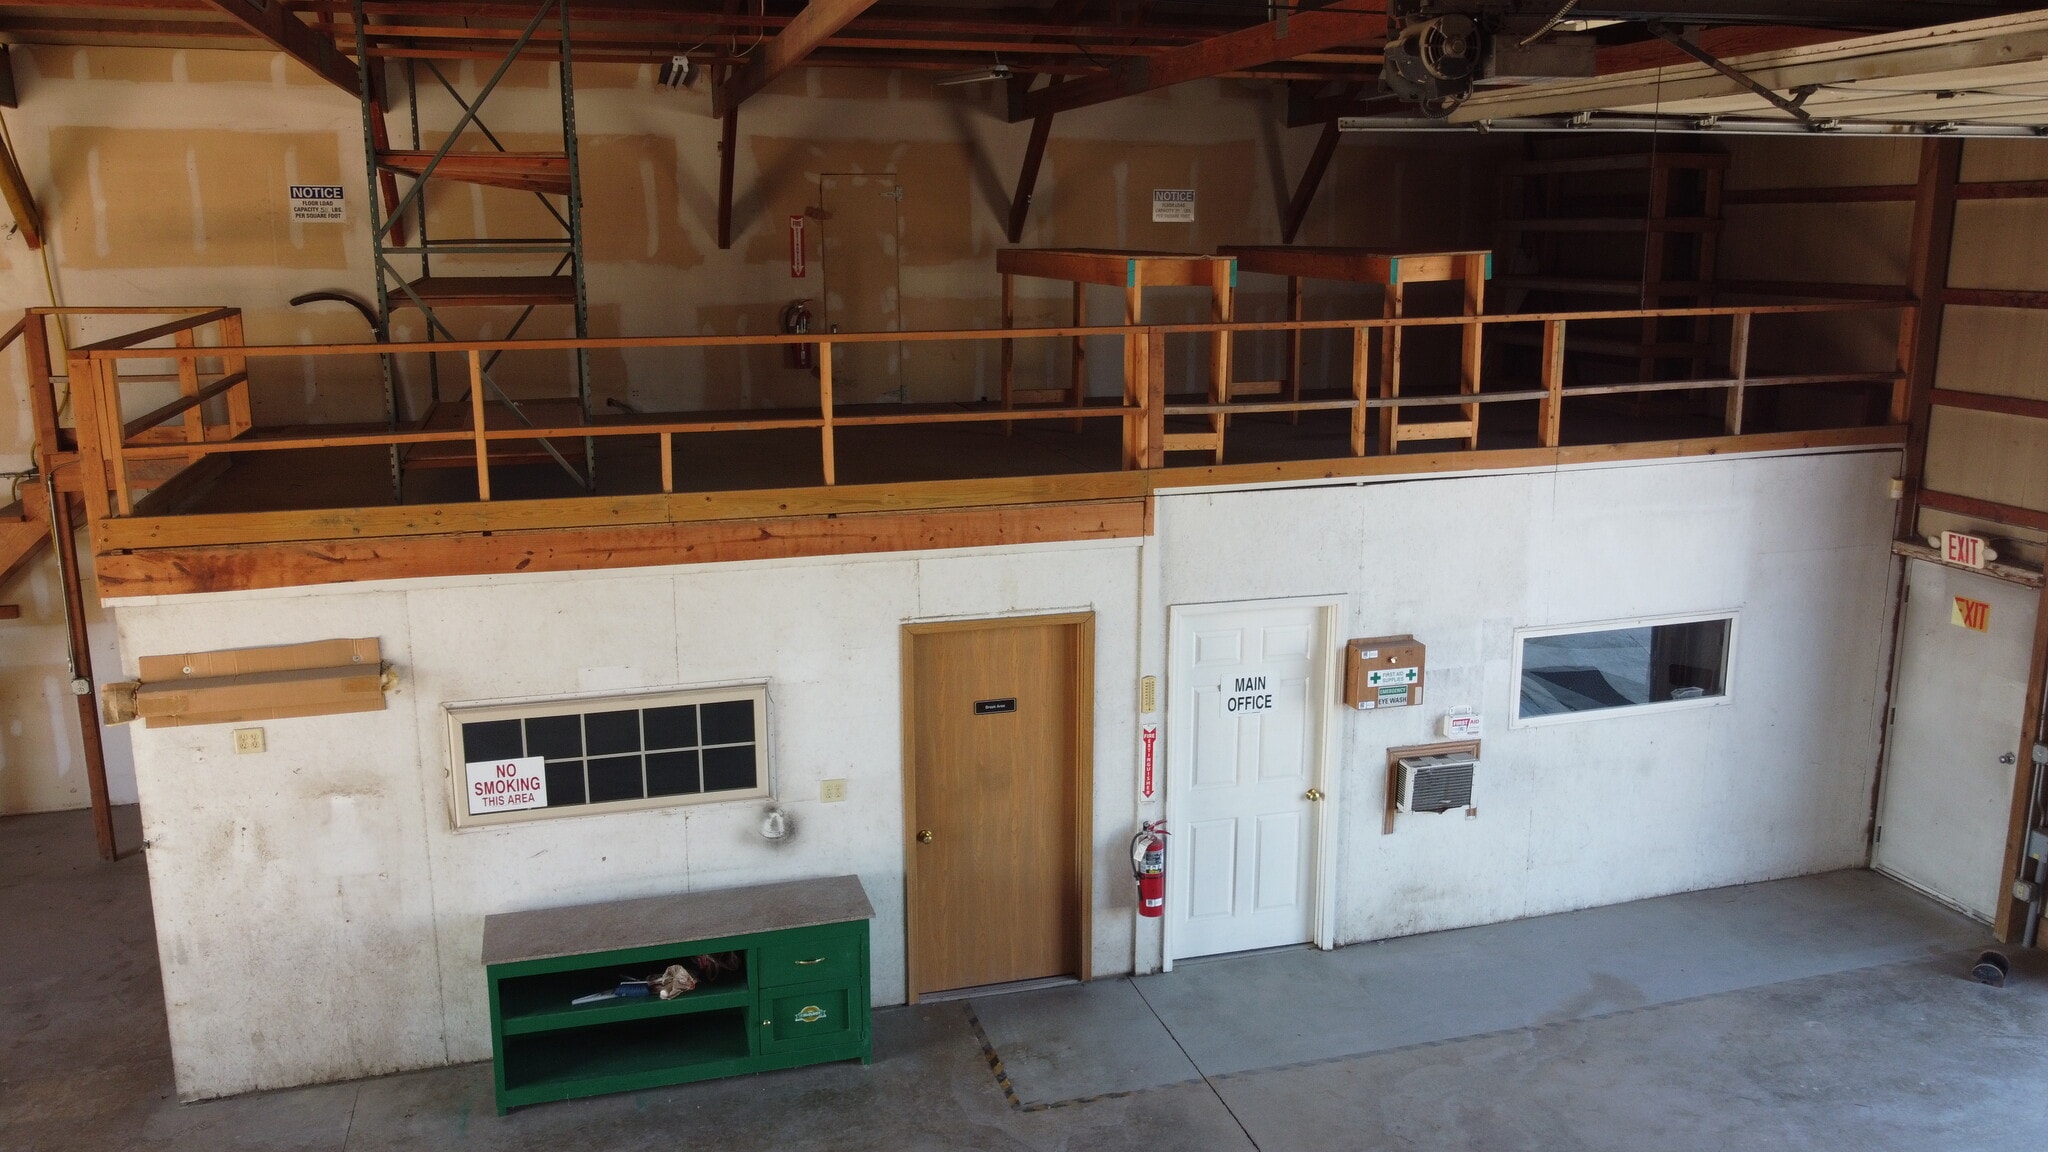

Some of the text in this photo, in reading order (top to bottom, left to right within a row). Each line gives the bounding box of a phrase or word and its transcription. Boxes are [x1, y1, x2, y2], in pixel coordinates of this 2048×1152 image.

[292, 187, 342, 198] NOTICE
[1155, 191, 1193, 201] NOTICE
[1948, 534, 1978, 565] EXIT
[1235, 676, 1266, 692] MAIN
[1380, 687, 1407, 695] EMERGENCY
[1227, 694, 1273, 712] OFFICE
[1389, 696, 1407, 704] WASH
[496, 763, 517, 778] NO
[474, 776, 541, 796] SMOKING
[482, 793, 536, 807] THIS AREA
